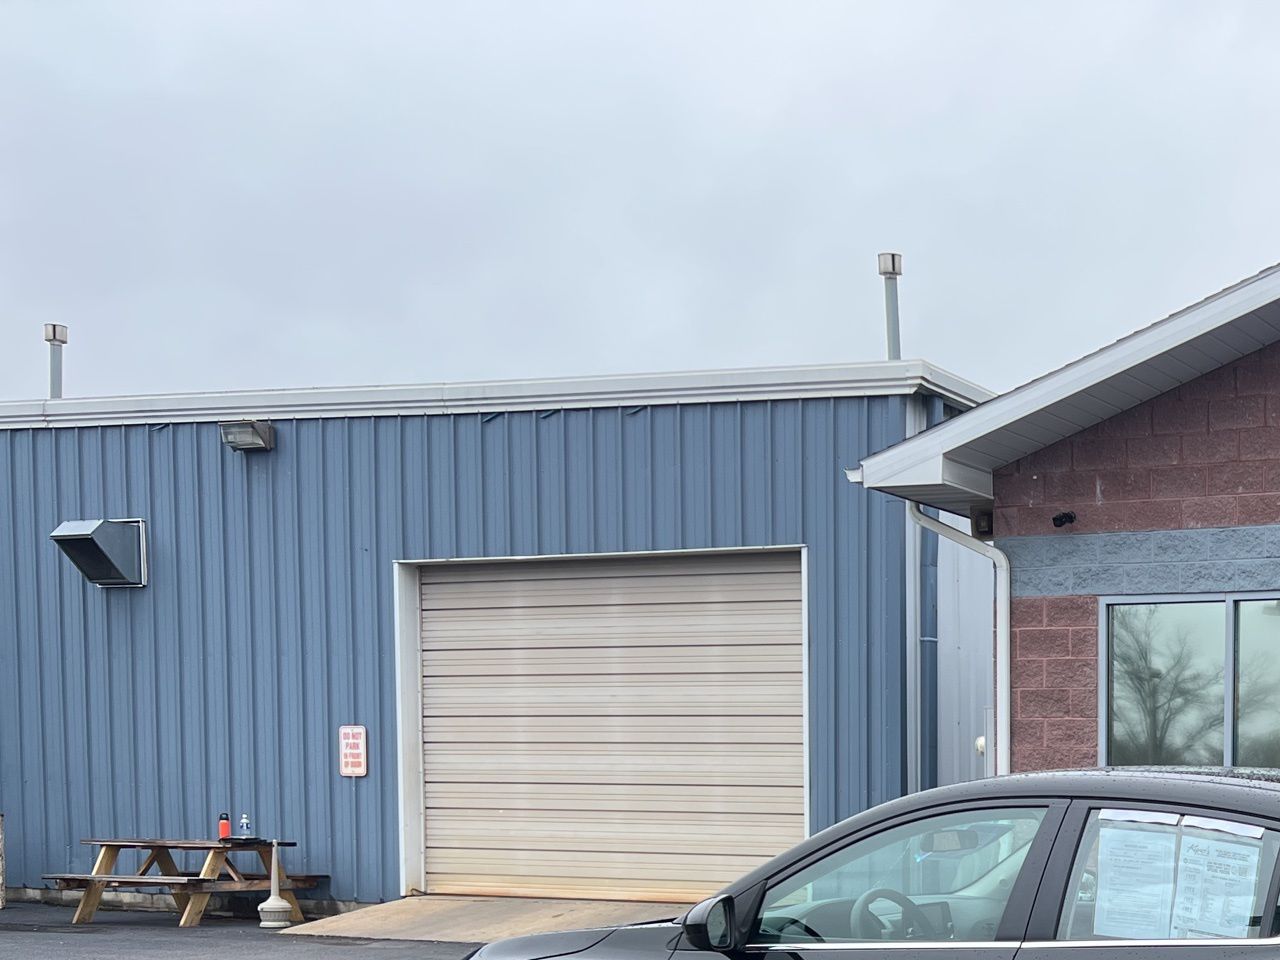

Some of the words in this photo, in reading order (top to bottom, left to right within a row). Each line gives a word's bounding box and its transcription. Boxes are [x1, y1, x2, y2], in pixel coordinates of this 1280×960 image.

[343, 732, 350, 740] DO
[351, 732, 362, 740] NOT
[345, 742, 360, 750] PARK
